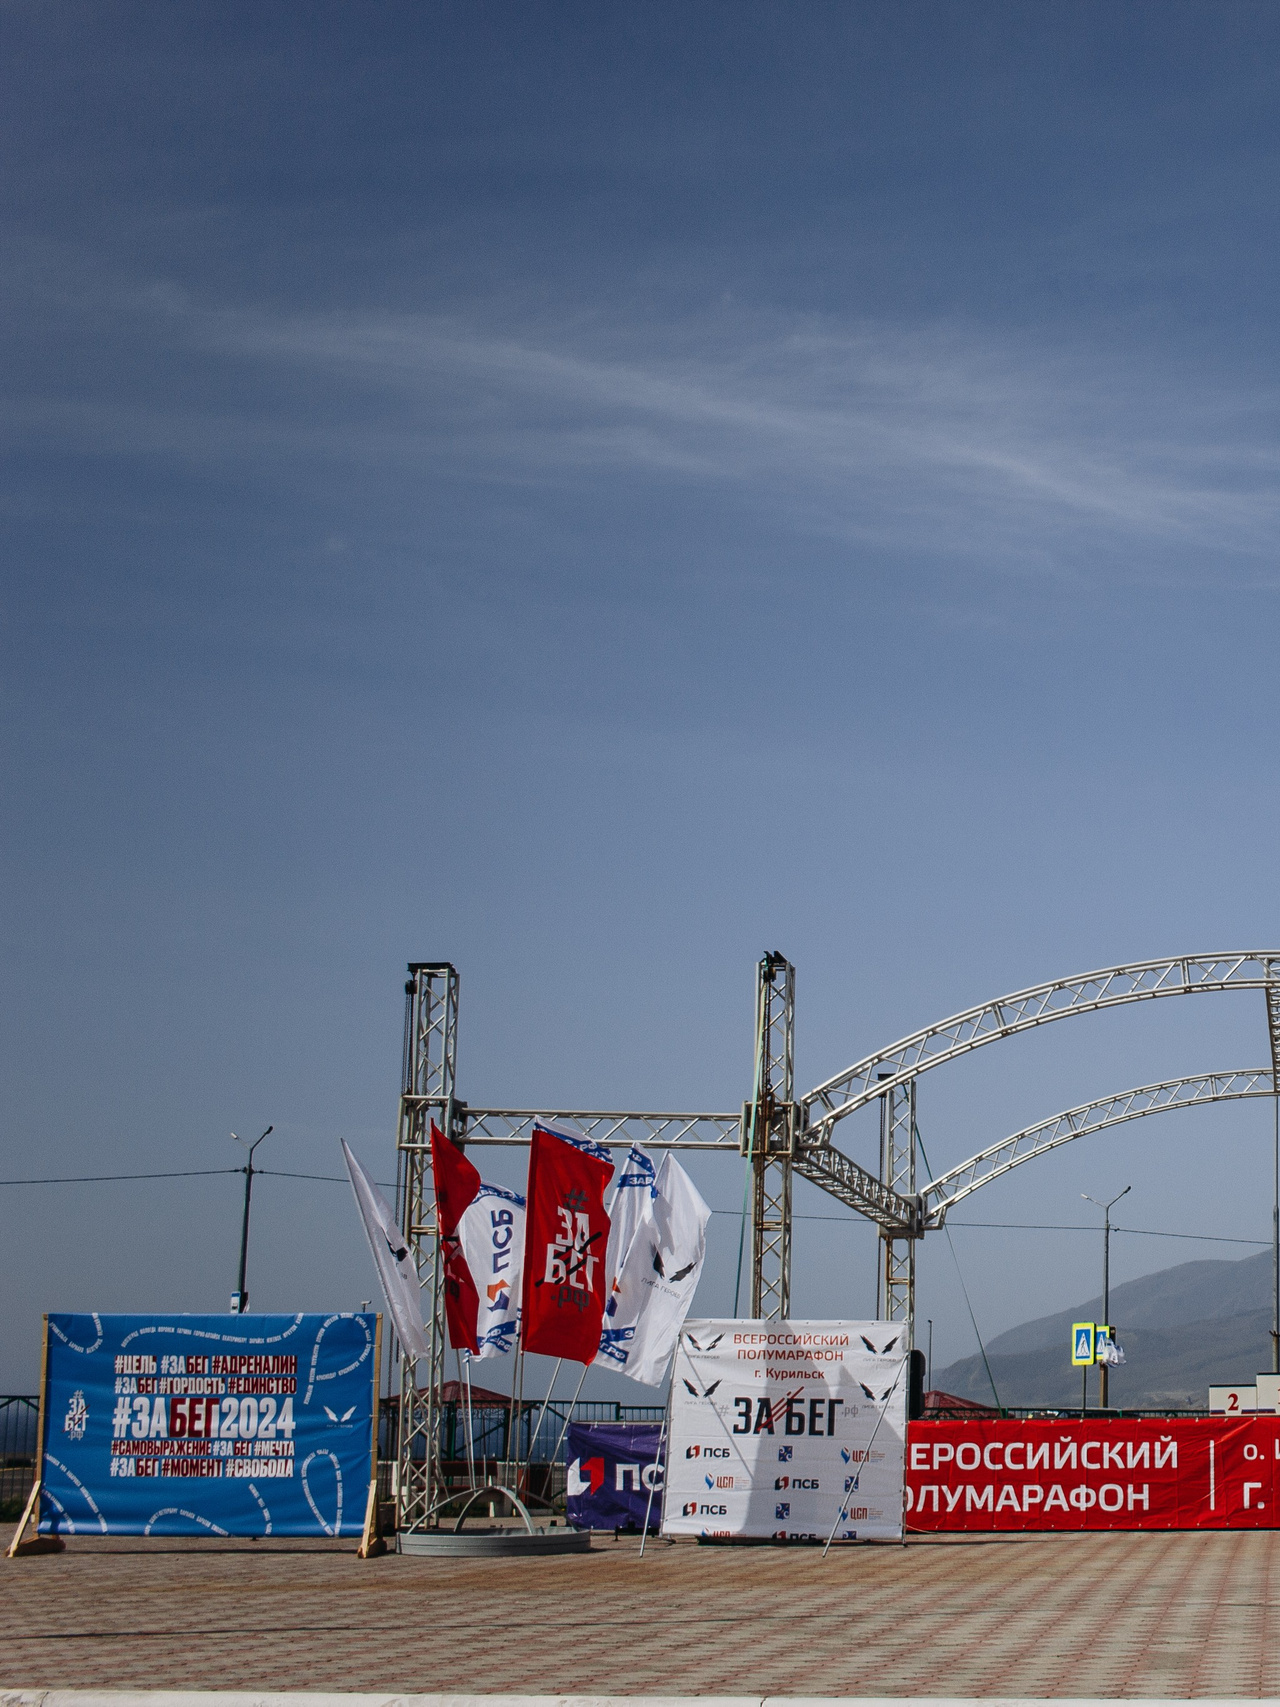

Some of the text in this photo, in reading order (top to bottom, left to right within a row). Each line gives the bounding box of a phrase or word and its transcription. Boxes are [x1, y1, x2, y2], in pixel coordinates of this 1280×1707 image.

[491, 1209, 514, 1273] ПСБ
[733, 1333, 849, 1346] ВСЕРОССИЙСКИЙ
[737, 1349, 844, 1361] ПОЛУМАРАФОН
[114, 1355, 297, 1375] #ЦЕЛЬ #ЗАБЕГ #АДРЕНАЛИН
[754, 1367, 825, 1381] г. Курильск
[114, 1377, 297, 1395] #ЗАБЕГ #ГОРДОСТЬ #ЕДИНСТВО
[1228, 1393, 1239, 1410] 2
[112, 1396, 296, 1439] #ЗАБЕГ2024
[111, 1440, 296, 1456] #САМОВЫРАЖЕНИЕ #ЗАБЕГ #МЕЧТА
[703, 1447, 731, 1458] ПСБ
[907, 1435, 1178, 1470] ЕРОССИЙСКИЙ
[1242, 1443, 1265, 1461] о.
[110, 1458, 294, 1477] #ЗАБЕГ #МОМЕНТ #СВОБОДА
[616, 1463, 666, 1492] ПС
[716, 1476, 734, 1489] ЦСП
[792, 1479, 820, 1489] ПСБ
[1243, 1482, 1265, 1509] г.
[700, 1505, 727, 1515] ПСБ
[850, 1507, 868, 1520] ЦСП
